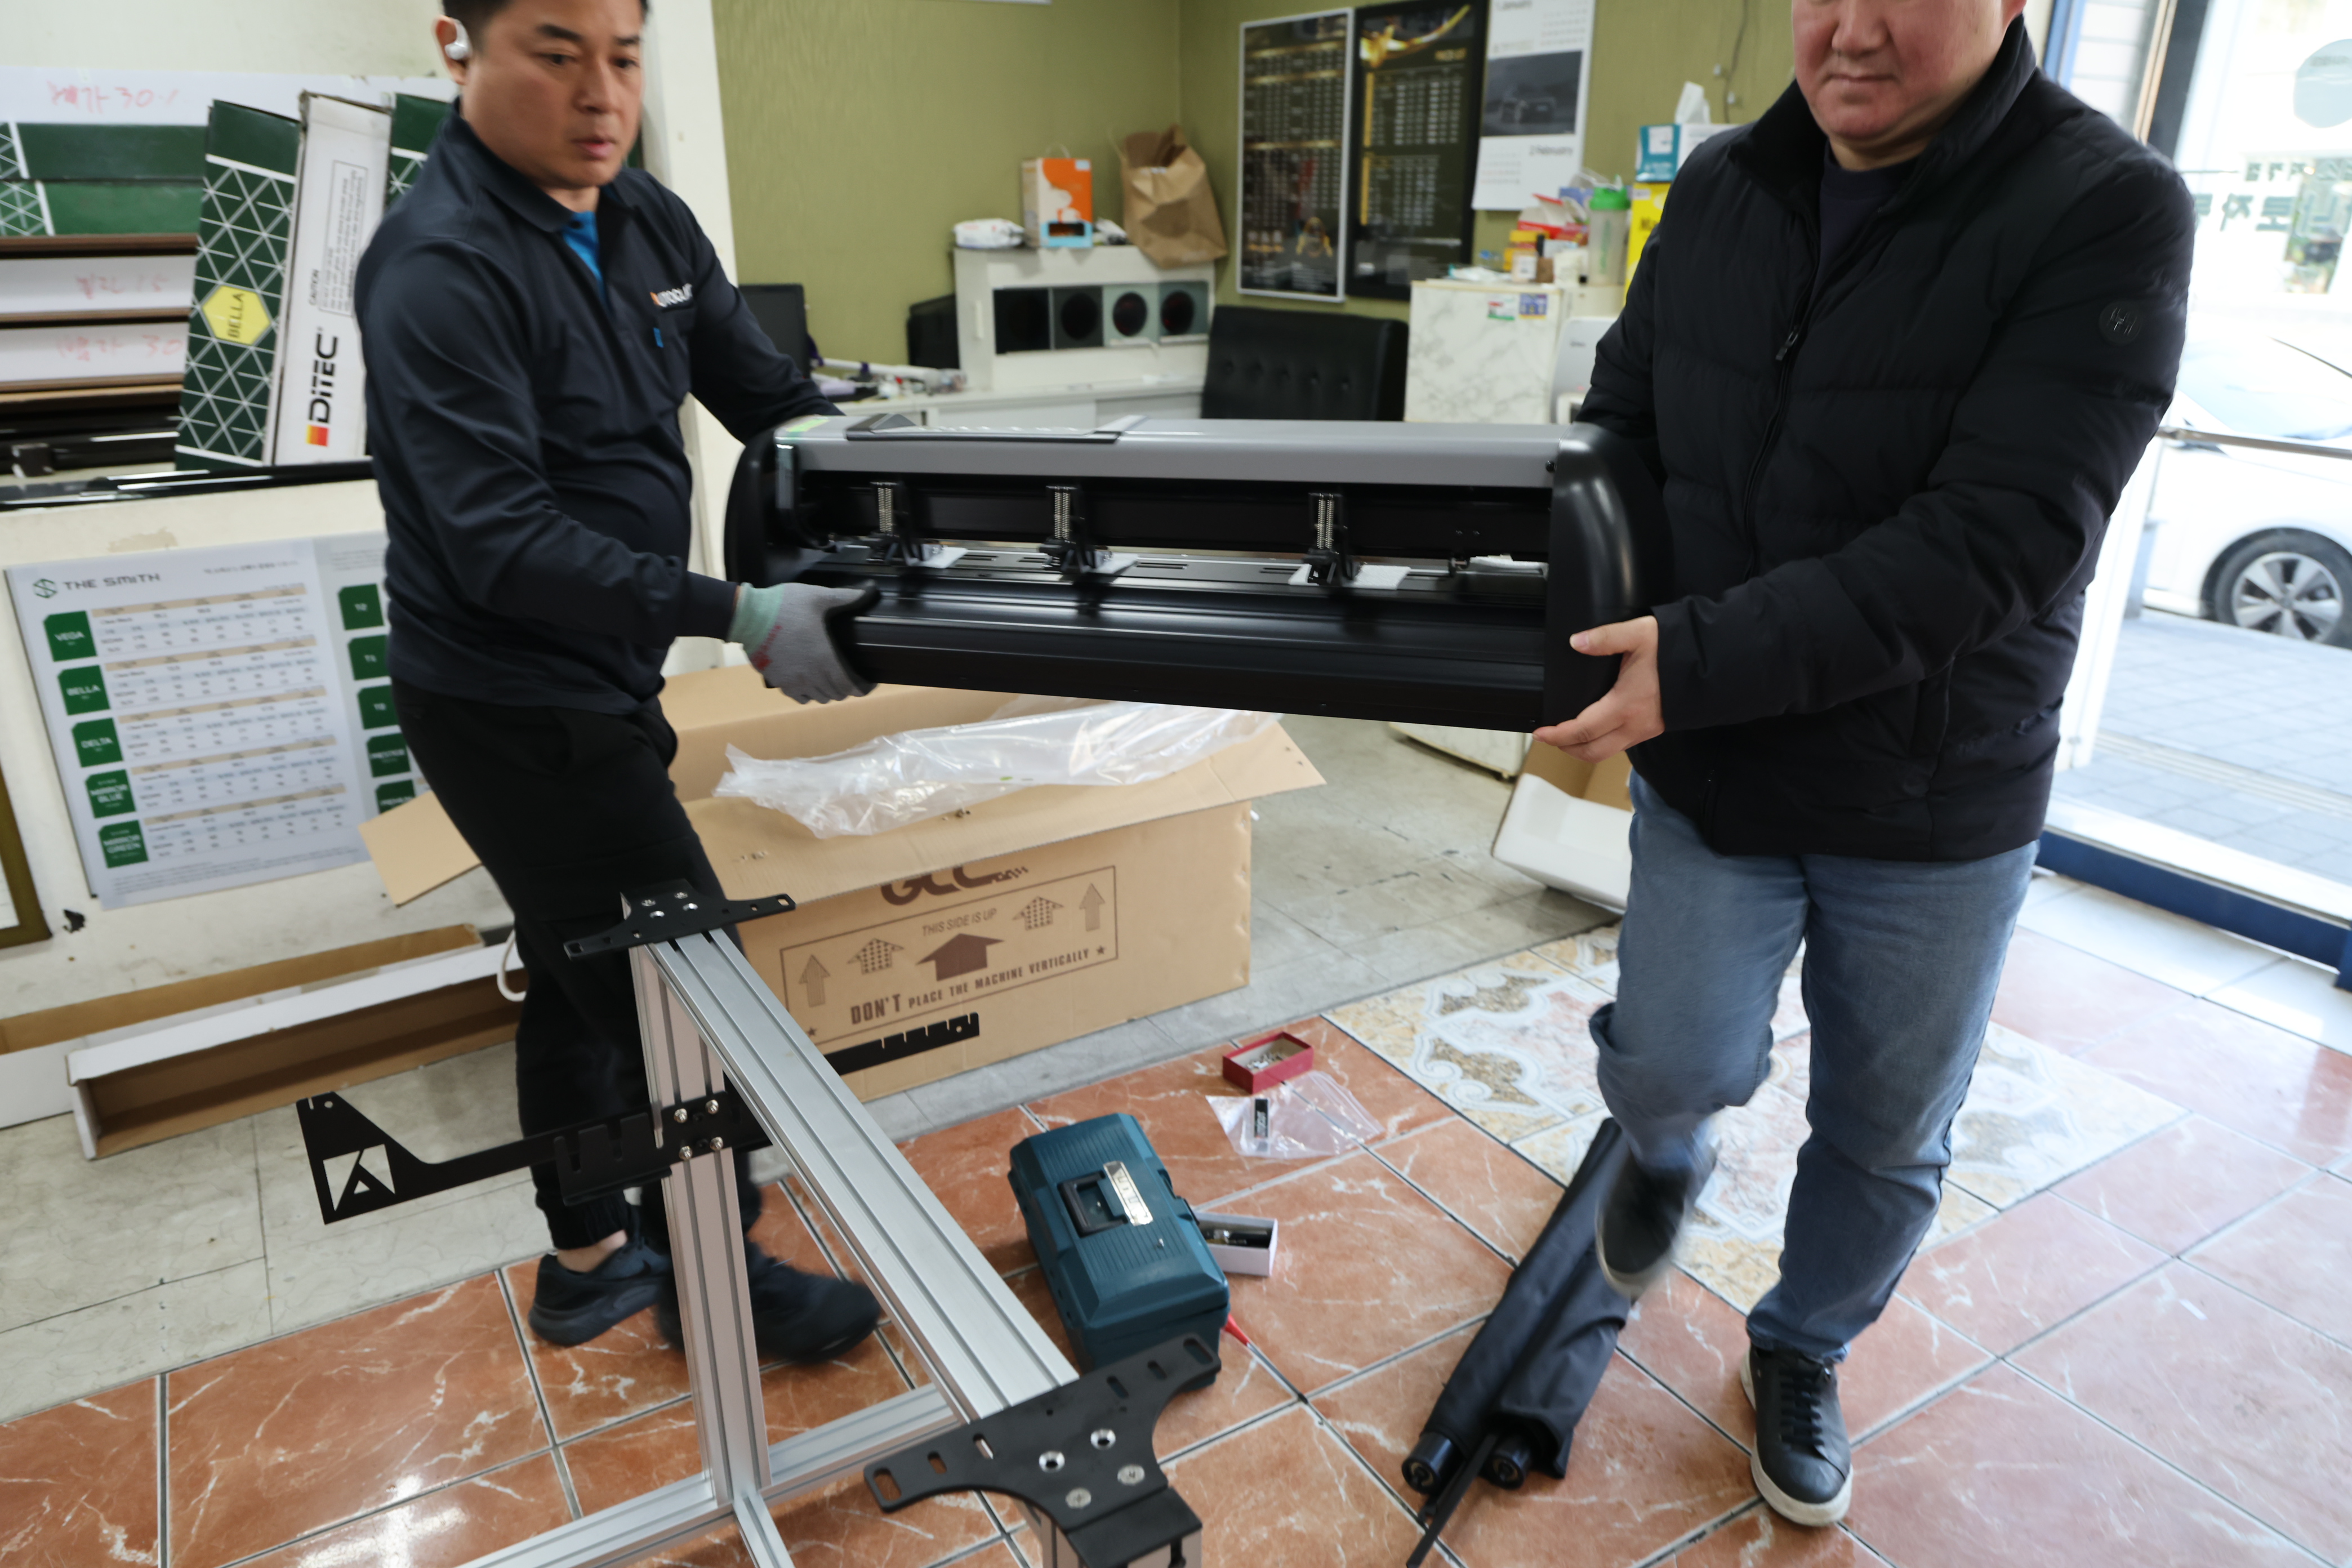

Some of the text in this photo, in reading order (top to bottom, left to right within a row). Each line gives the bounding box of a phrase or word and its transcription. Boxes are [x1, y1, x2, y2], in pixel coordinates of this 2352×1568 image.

[228, 292, 245, 338] BELLA
[63, 573, 161, 590] THE SMITH
[66, 684, 101, 697] BELLA
[922, 907, 997, 937] THIS SIDE IS UP
[850, 947, 1090, 1024] DON'T PLACE THE MACHINE VERTICALLY
